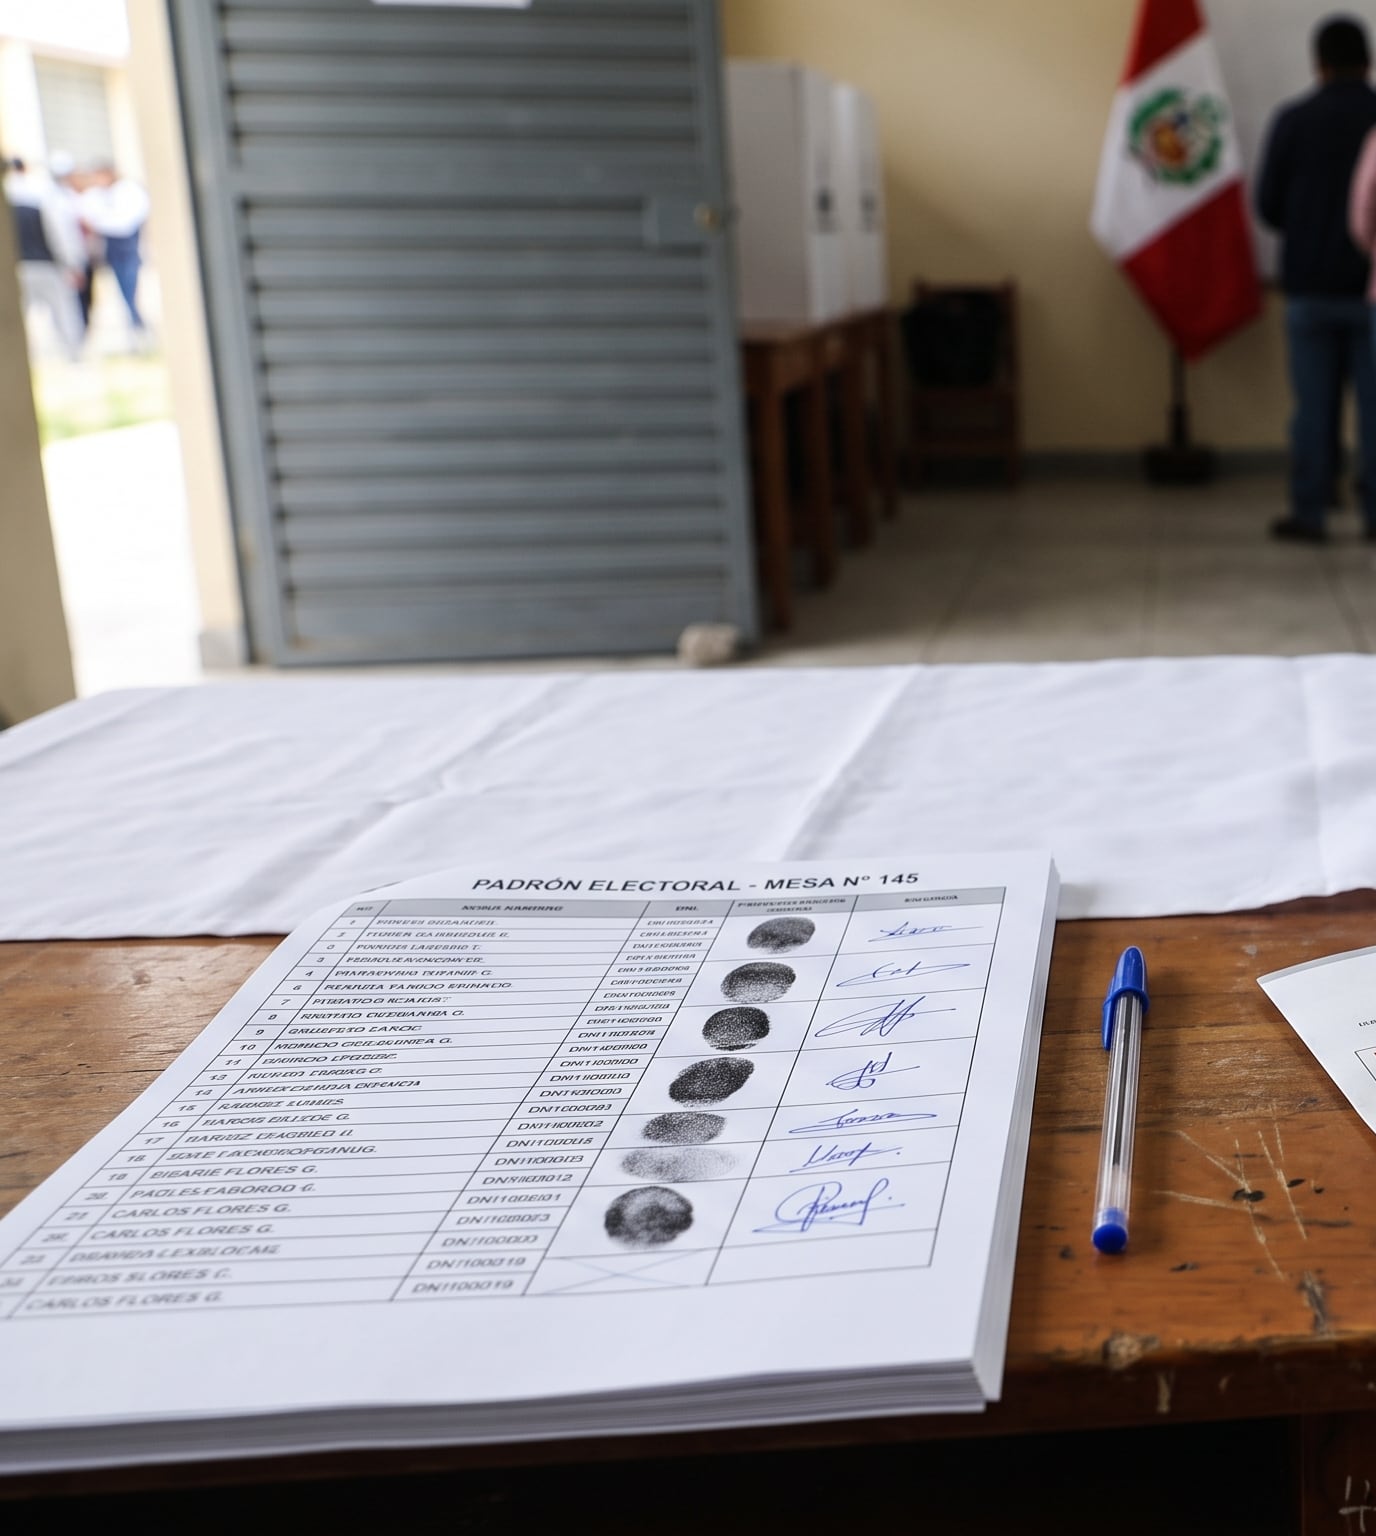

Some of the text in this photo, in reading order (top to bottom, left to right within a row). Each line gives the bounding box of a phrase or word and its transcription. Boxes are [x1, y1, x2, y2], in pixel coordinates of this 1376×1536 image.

[472, 877, 583, 892] PADRÓN
[588, 879, 740, 891] ELECTORAL
[764, 877, 836, 890] MESA
[879, 873, 919, 885] 145
[225, 1165, 298, 1178] FLORES
[111, 1206, 188, 1220] CARLOS
[191, 1204, 270, 1217] FLORES
[90, 1227, 171, 1241] CARLOS
[173, 1225, 253, 1238] FLORES
[25, 1295, 111, 1311] CARLOS
[116, 1291, 203, 1306] FLORES
